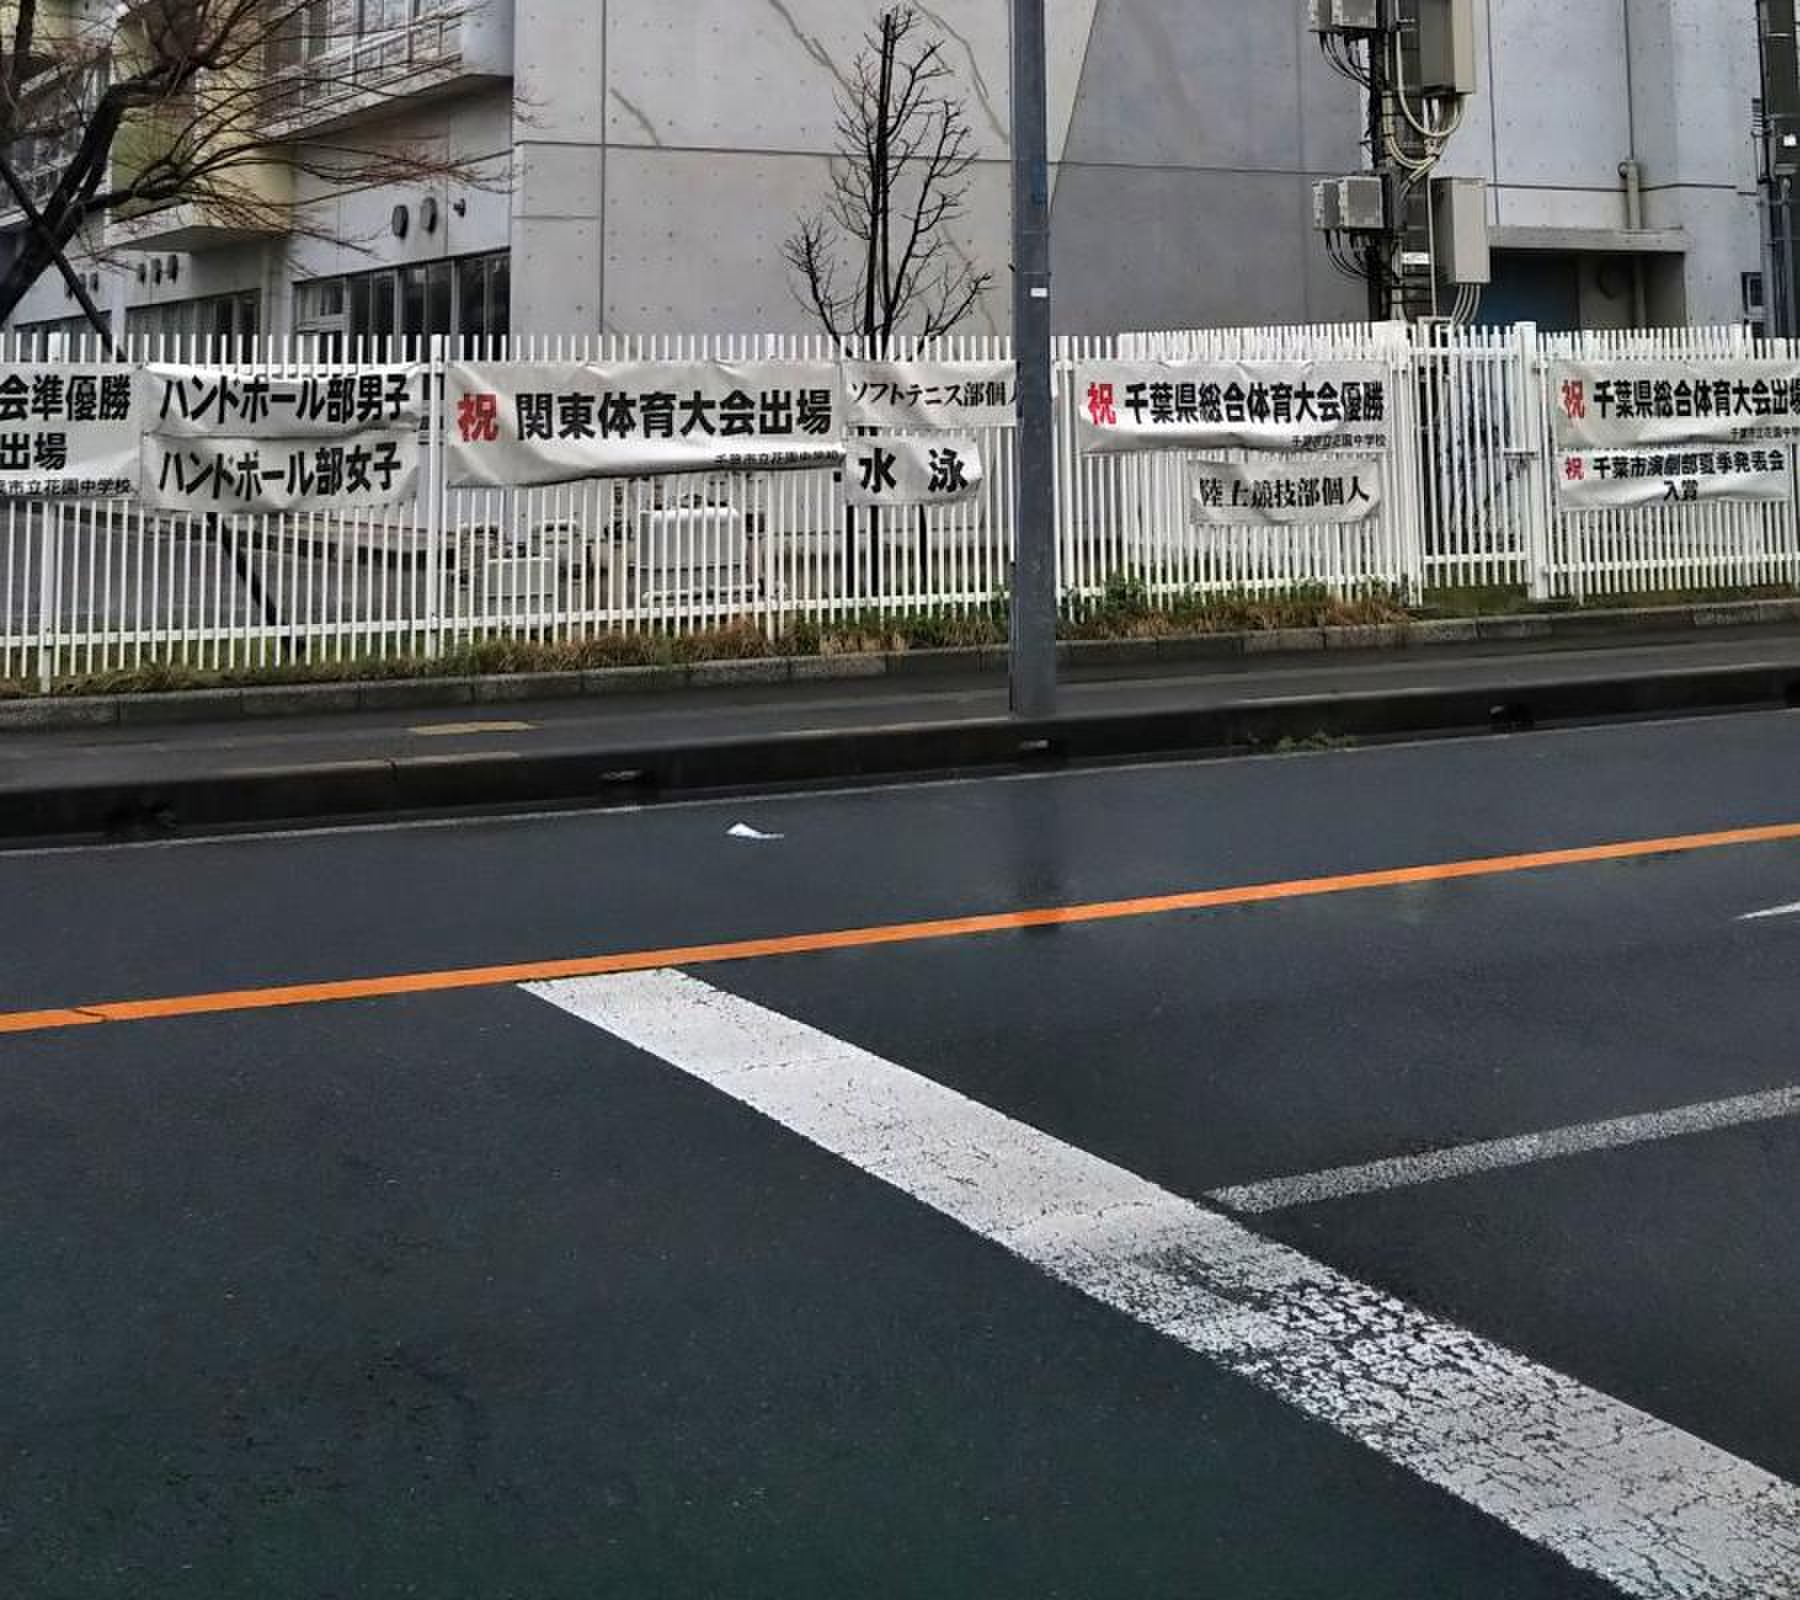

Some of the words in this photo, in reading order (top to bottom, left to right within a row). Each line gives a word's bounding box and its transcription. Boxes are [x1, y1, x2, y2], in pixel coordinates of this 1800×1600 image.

[0, 374, 131, 421] 会準優勝
[160, 373, 410, 424] ハンドボール部男子
[458, 393, 498, 441] 祝
[516, 389, 832, 441] 関東体育大会出場
[1087, 383, 1116, 424] 祝
[1124, 381, 1384, 424] 千葉県総合体育大会優勝
[1561, 380, 1585, 419] 祝
[0, 432, 67, 470] 出場
[159, 442, 401, 500] ハンドボール部女子
[859, 448, 969, 493] 水泳
[1565, 457, 1585, 480] 祝
